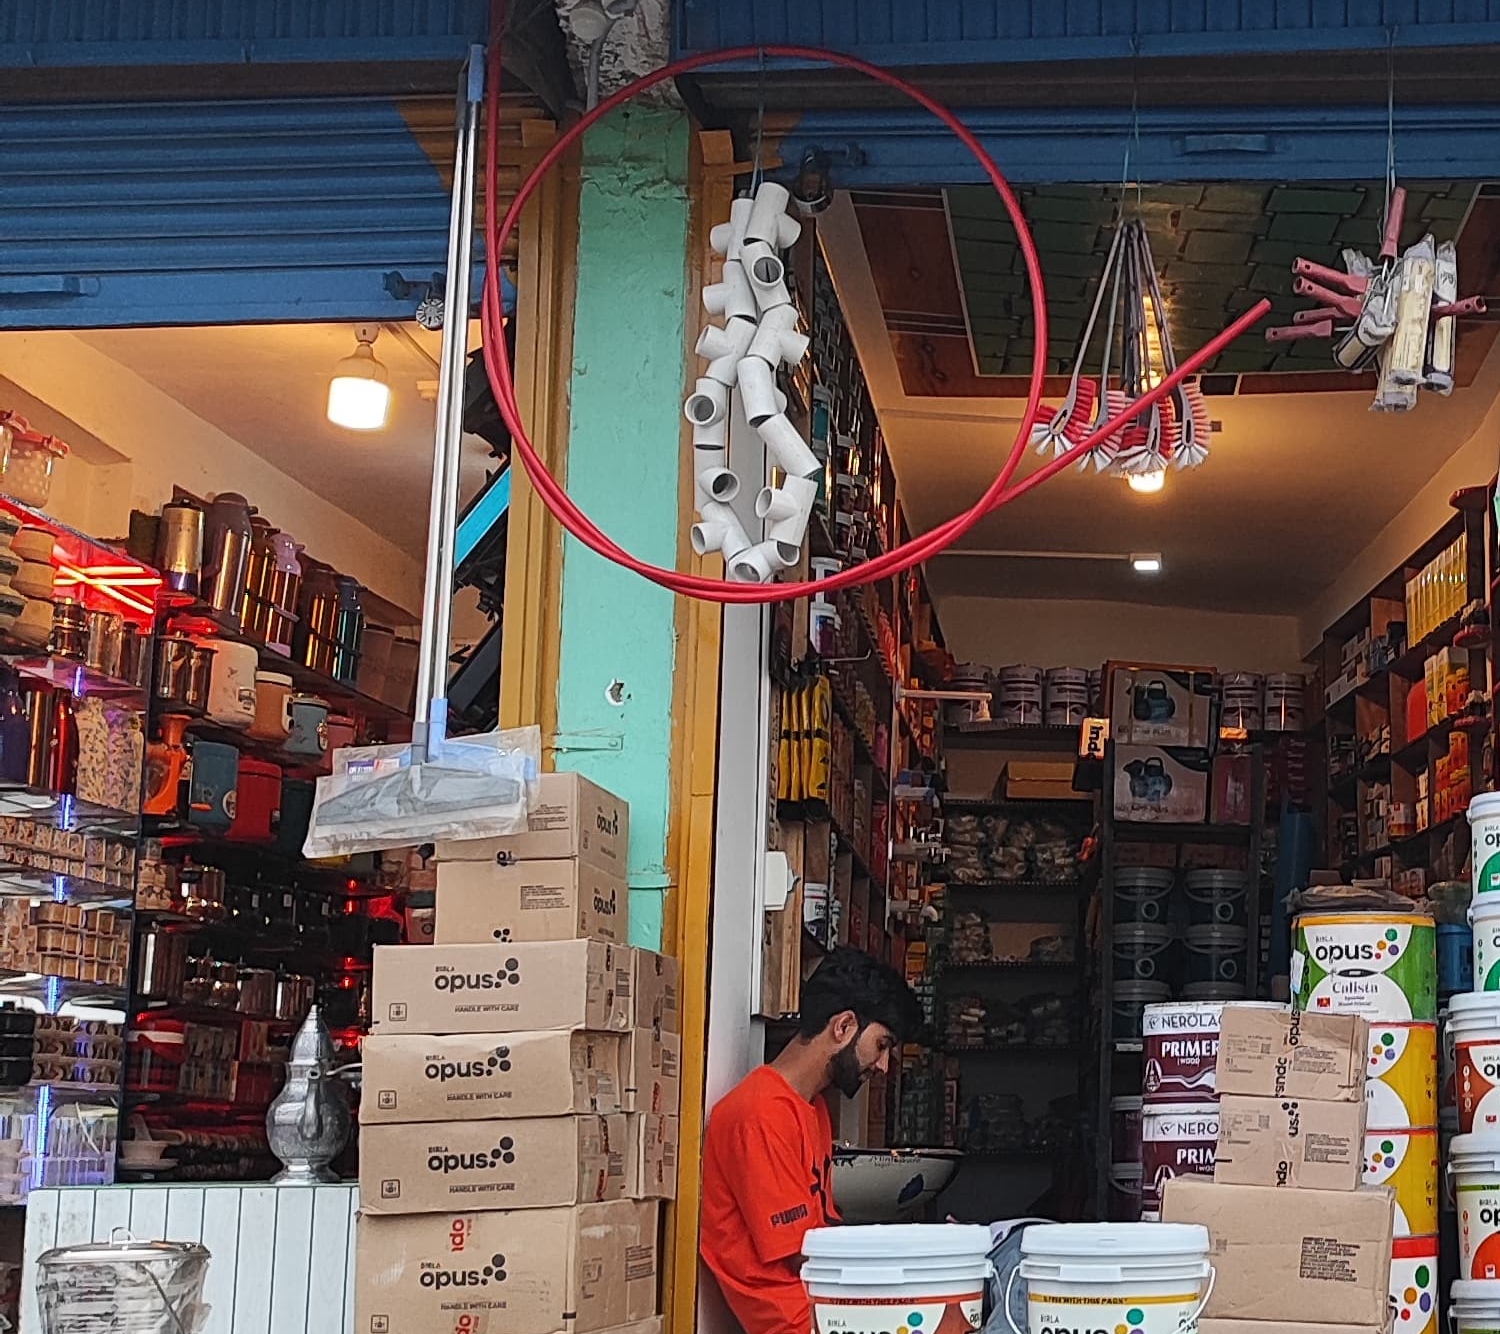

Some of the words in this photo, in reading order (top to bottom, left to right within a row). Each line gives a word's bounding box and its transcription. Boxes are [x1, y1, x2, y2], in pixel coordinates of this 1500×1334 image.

[1315, 943, 1374, 964] opus
[1161, 1014, 1222, 1029] NEROLA
[1177, 1122, 1219, 1135] NERO
